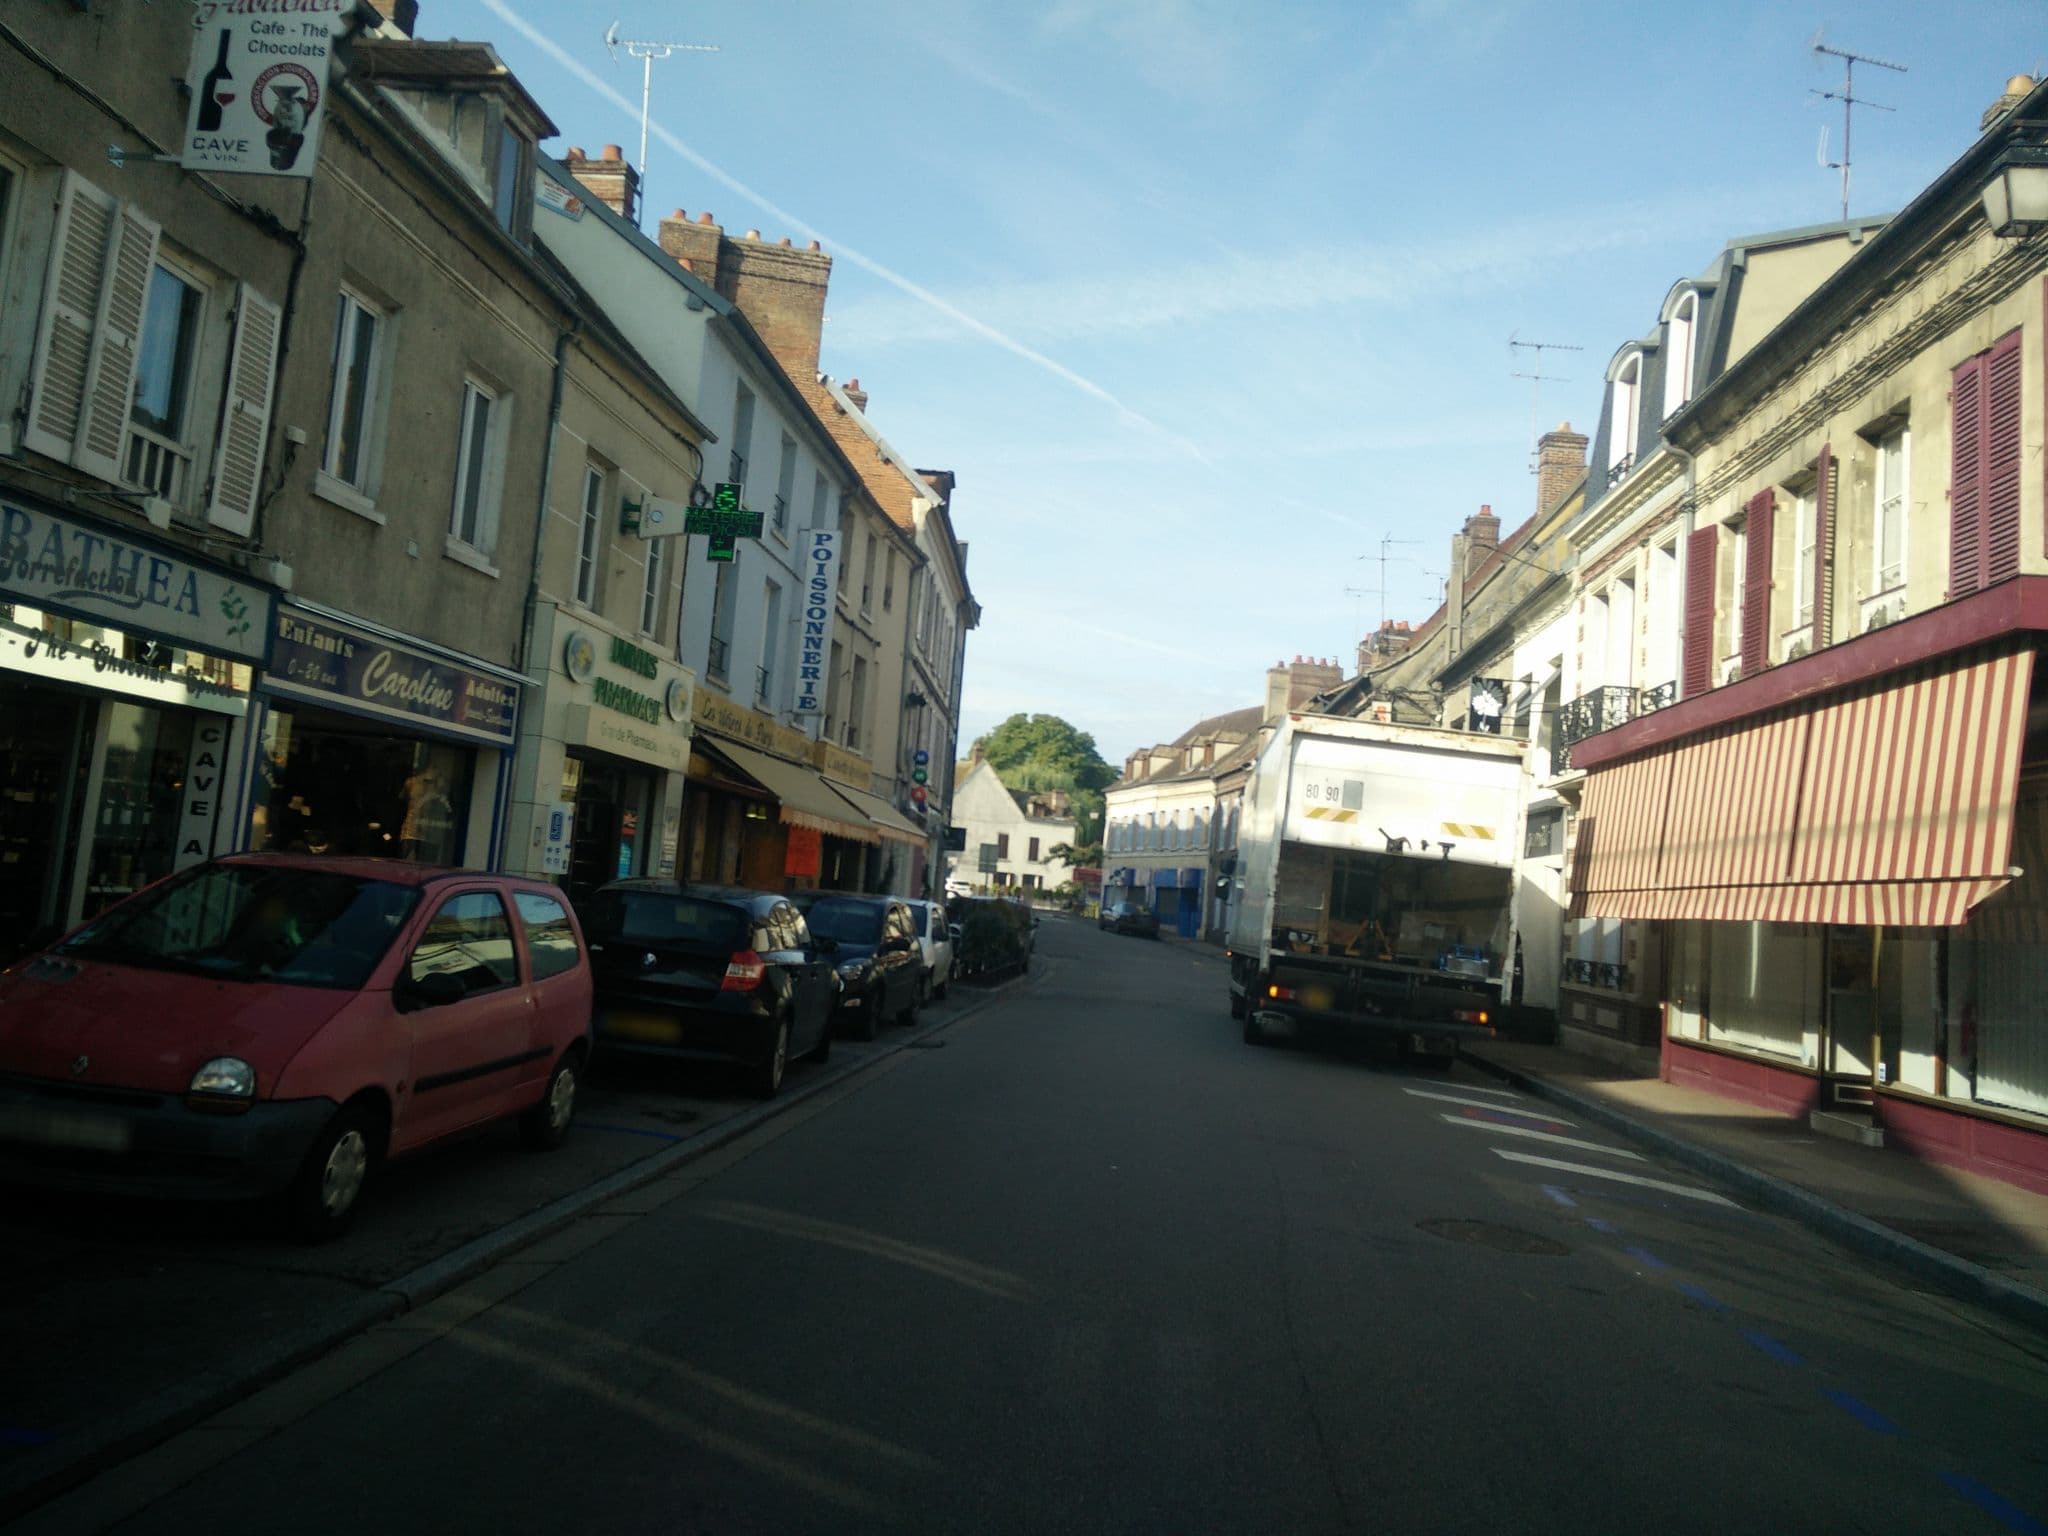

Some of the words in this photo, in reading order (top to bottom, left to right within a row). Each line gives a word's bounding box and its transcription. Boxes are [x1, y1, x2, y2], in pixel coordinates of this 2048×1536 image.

[247, 39, 326, 57] Chocolats
[192, 137, 249, 152] CAVE
[213, 154, 238, 162] VIN
[798, 532, 833, 710] POISSONNERIE
[279, 616, 354, 659] Enfants
[361, 651, 453, 710] Caroline
[187, 727, 219, 817] CAVE
[1326, 786, 1340, 801] 90
